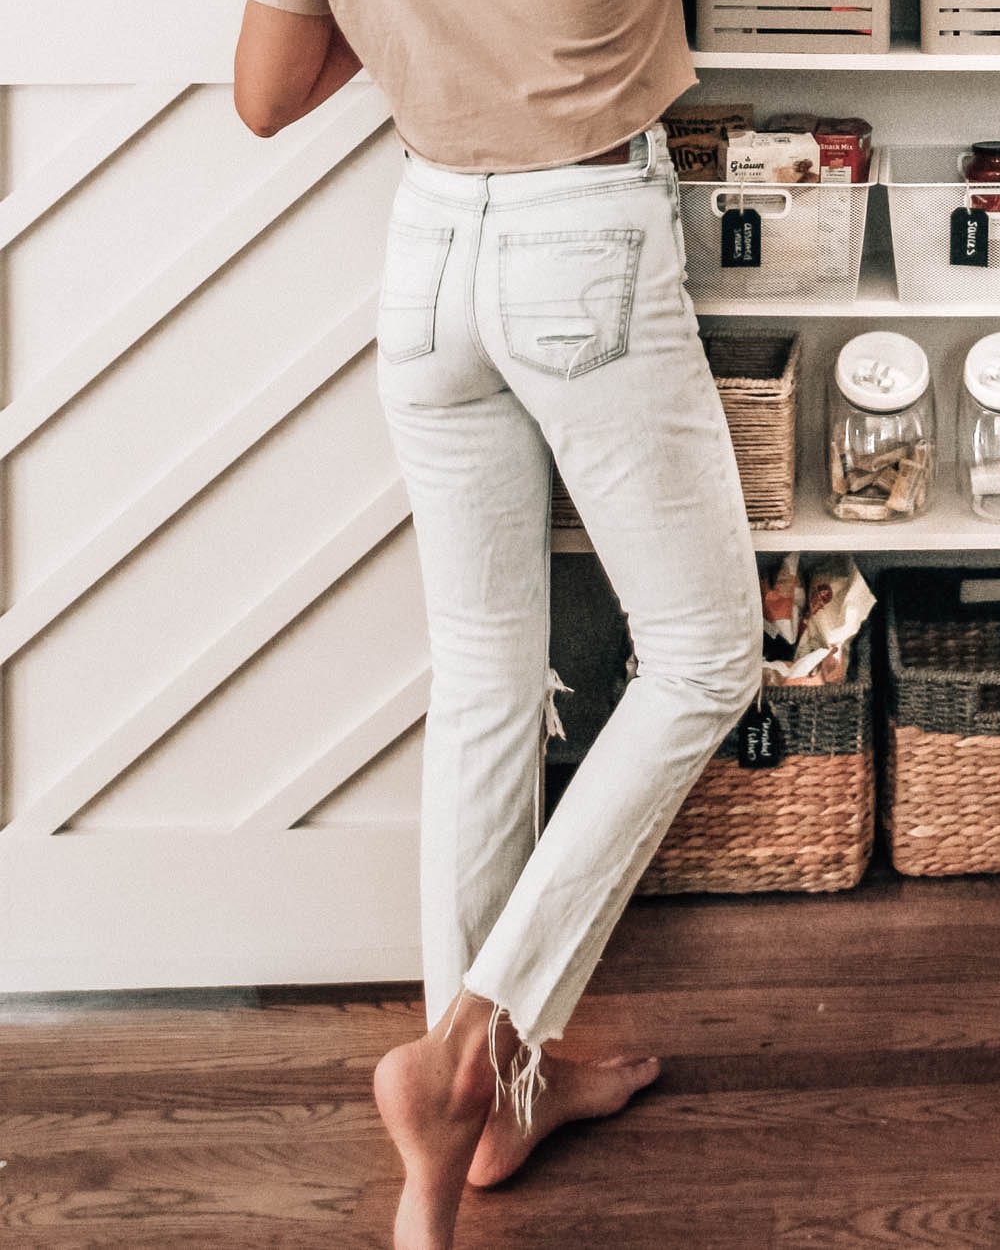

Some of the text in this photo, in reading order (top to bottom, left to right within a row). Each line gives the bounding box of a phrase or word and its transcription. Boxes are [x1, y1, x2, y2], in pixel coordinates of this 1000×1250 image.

[820, 143, 853, 151] Snack Mix
[730, 161, 764, 172] Grown
[966, 220, 978, 256] sauces
